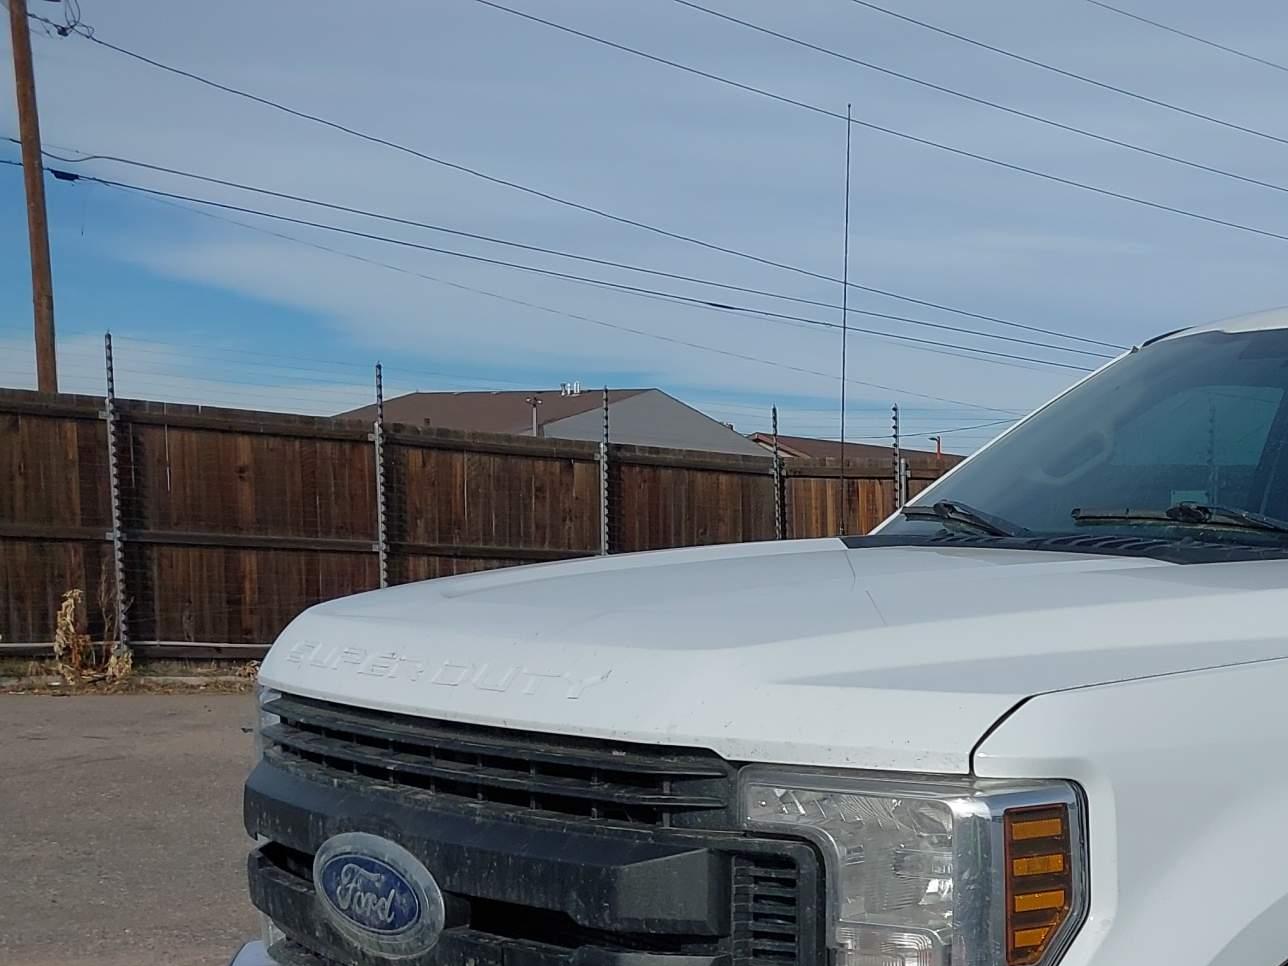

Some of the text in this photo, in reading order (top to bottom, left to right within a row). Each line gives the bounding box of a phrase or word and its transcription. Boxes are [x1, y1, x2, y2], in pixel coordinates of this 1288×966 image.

[284, 640, 613, 699] SUPER DUTY
[336, 863, 396, 924] Ford
